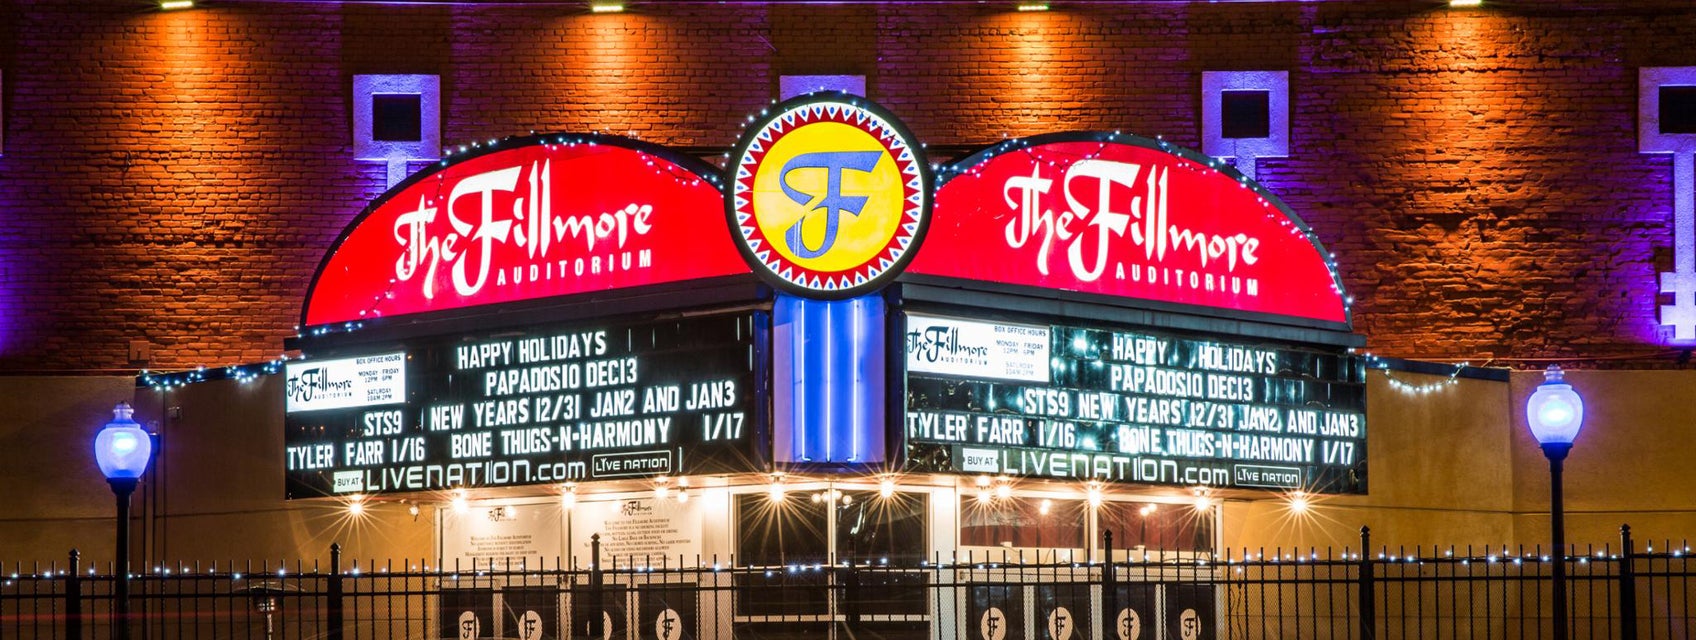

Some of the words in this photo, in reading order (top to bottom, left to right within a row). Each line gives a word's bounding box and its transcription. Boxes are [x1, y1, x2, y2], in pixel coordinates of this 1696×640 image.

[779, 151, 883, 258] F
[1004, 161, 1073, 275] The
[1064, 159, 1260, 282] Fillmore
[394, 193, 457, 299] The
[448, 158, 653, 296] Fillmore
[497, 249, 652, 286] AUDITORIUM
[1116, 262, 1259, 296] AUDITORIUM
[907, 328, 928, 361] The
[925, 326, 988, 362] Fillmore
[994, 325, 1005, 333] BOX
[1007, 327, 1026, 335] OFFICE
[1028, 329, 1046, 337] HOURS
[1024, 342, 1043, 350] FRIDAY
[367, 356, 384, 364] OFFICE
[385, 354, 401, 363] HOURS
[458, 341, 512, 370] HAPPY
[519, 331, 607, 364] HOLIDAYS
[1113, 337, 1168, 365] HAPPY
[1199, 344, 1276, 375] HOLIDAYS
[288, 374, 304, 402] The
[302, 367, 352, 402] Fillmore
[486, 363, 580, 396] PAPADOSIO
[586, 358, 637, 388] DEC13
[1111, 365, 1202, 398] PAPADOSIO
[1208, 373, 1253, 401] DEC13
[364, 410, 402, 436] STS9
[431, 405, 464, 431] NEW
[474, 397, 529, 427] YEARS
[536, 394, 580, 422] 12/31
[591, 389, 635, 417] JAN2
[643, 385, 680, 414] AND
[686, 380, 735, 410] JAN3
[1025, 389, 1069, 417] STS9
[1079, 392, 1115, 420] NEW
[1125, 397, 1181, 425] YEARS
[1190, 402, 1233, 428] 12/31
[1240, 405, 1279, 431] JAN2
[1287, 409, 1317, 434] AND
[1321, 411, 1358, 437] JAN3
[287, 444, 334, 470] TYLER
[345, 440, 384, 466] FARR
[392, 437, 425, 463] 1/16
[451, 432, 492, 458] BONE
[501, 417, 671, 455] THUGS-N-HARMONY
[704, 412, 744, 441] 1/17
[907, 412, 967, 441] TYLER
[977, 416, 1024, 445] FARR
[1038, 420, 1075, 448] 1/16
[1118, 424, 1161, 454] BONE
[1166, 430, 1314, 463] THUGS-N-HARMONY
[1323, 440, 1354, 466] 1/17
[596, 457, 621, 472] LIVE
[623, 457, 668, 470] NATION
[967, 455, 983, 466] BUY
[984, 456, 994, 466] AT
[1237, 469, 1259, 482] LIVE
[1261, 471, 1298, 485] NATION
[337, 478, 350, 487] BUY
[351, 477, 359, 486] AT
